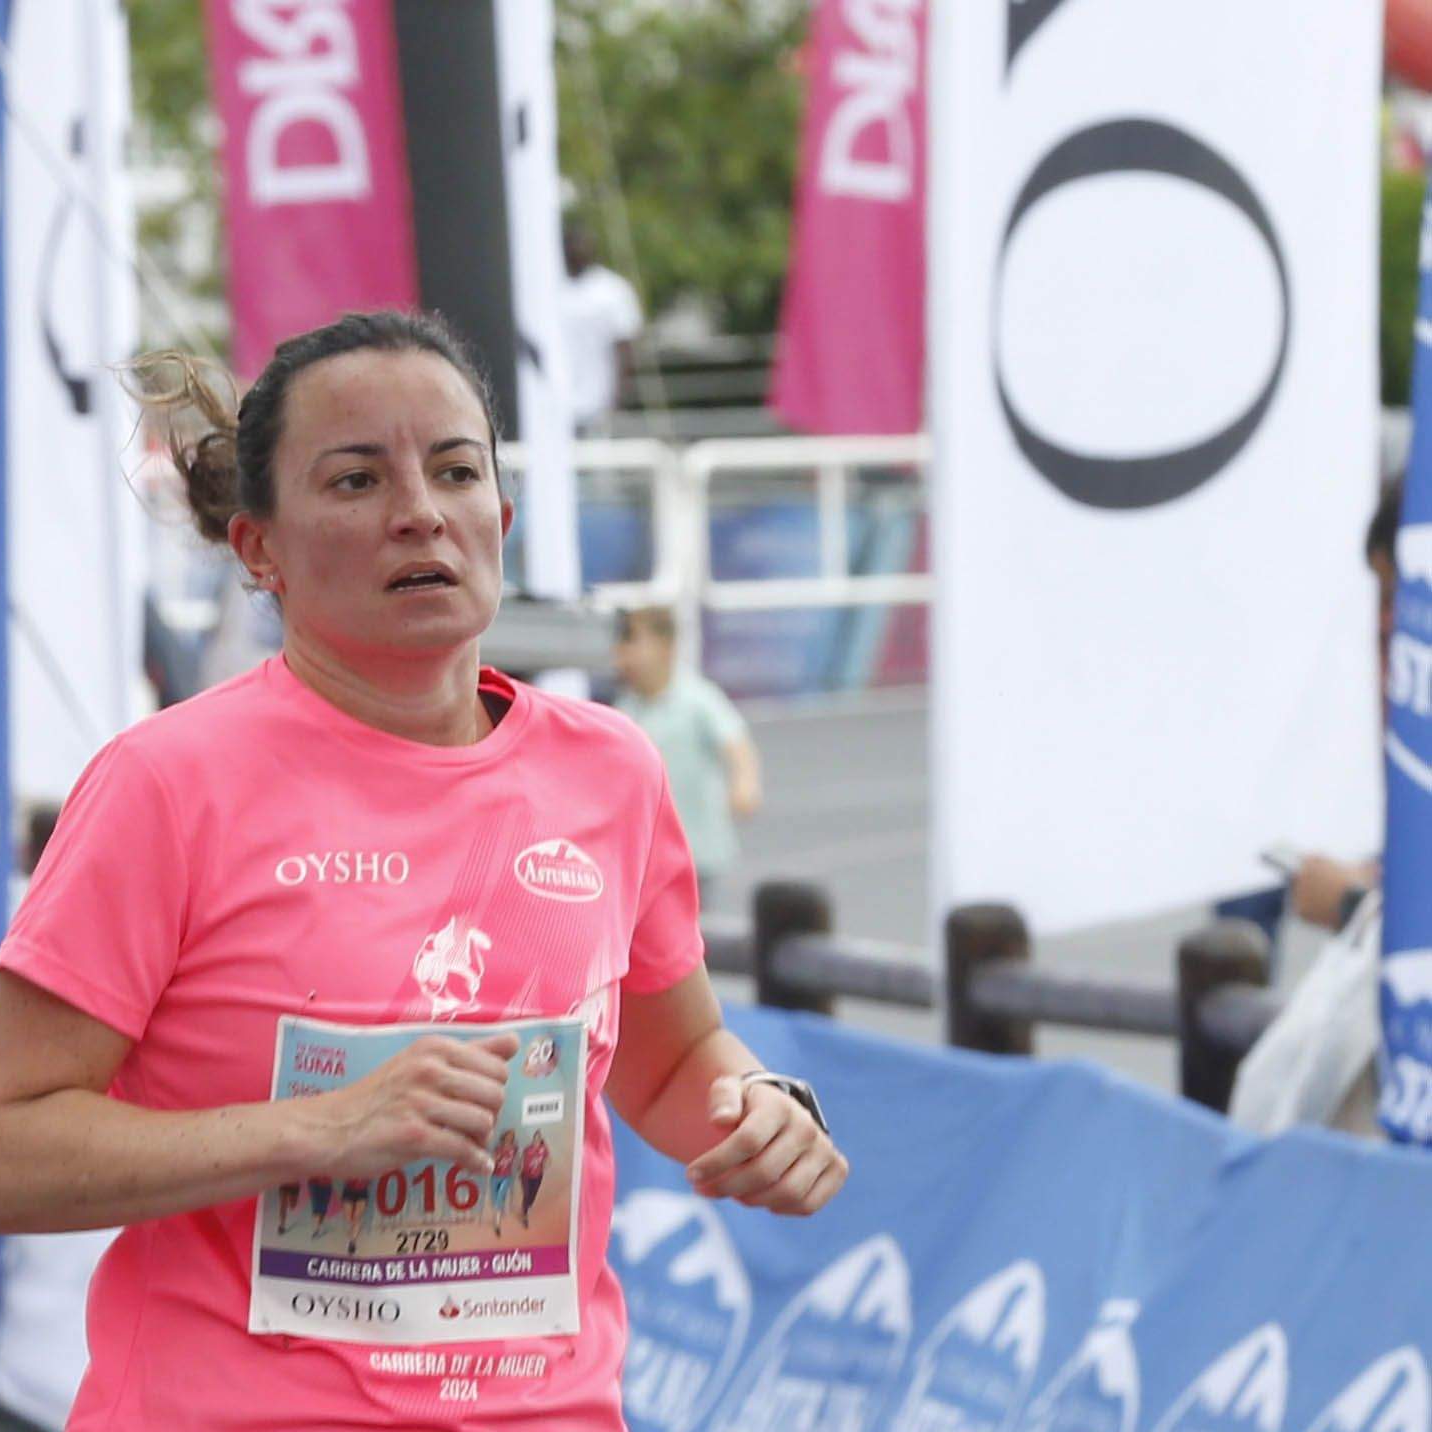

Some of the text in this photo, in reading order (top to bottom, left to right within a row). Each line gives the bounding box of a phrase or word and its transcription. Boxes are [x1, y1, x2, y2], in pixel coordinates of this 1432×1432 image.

[990, 0, 1292, 512] O
[275, 851, 409, 885] OYSHO
[376, 1162, 480, 1217] 016
[395, 1229, 450, 1255] 2729
[307, 1258, 383, 1282] CARRERA
[385, 1261, 406, 1280] DE
[409, 1259, 428, 1279] LA
[432, 1256, 481, 1277] MUJER
[292, 1292, 546, 1321] OYSHO Santander
[369, 1352, 446, 1376] CARRERA
[474, 1355, 494, 1376] LA
[496, 1355, 546, 1377] MUJER
[439, 1378, 478, 1401] 2024
